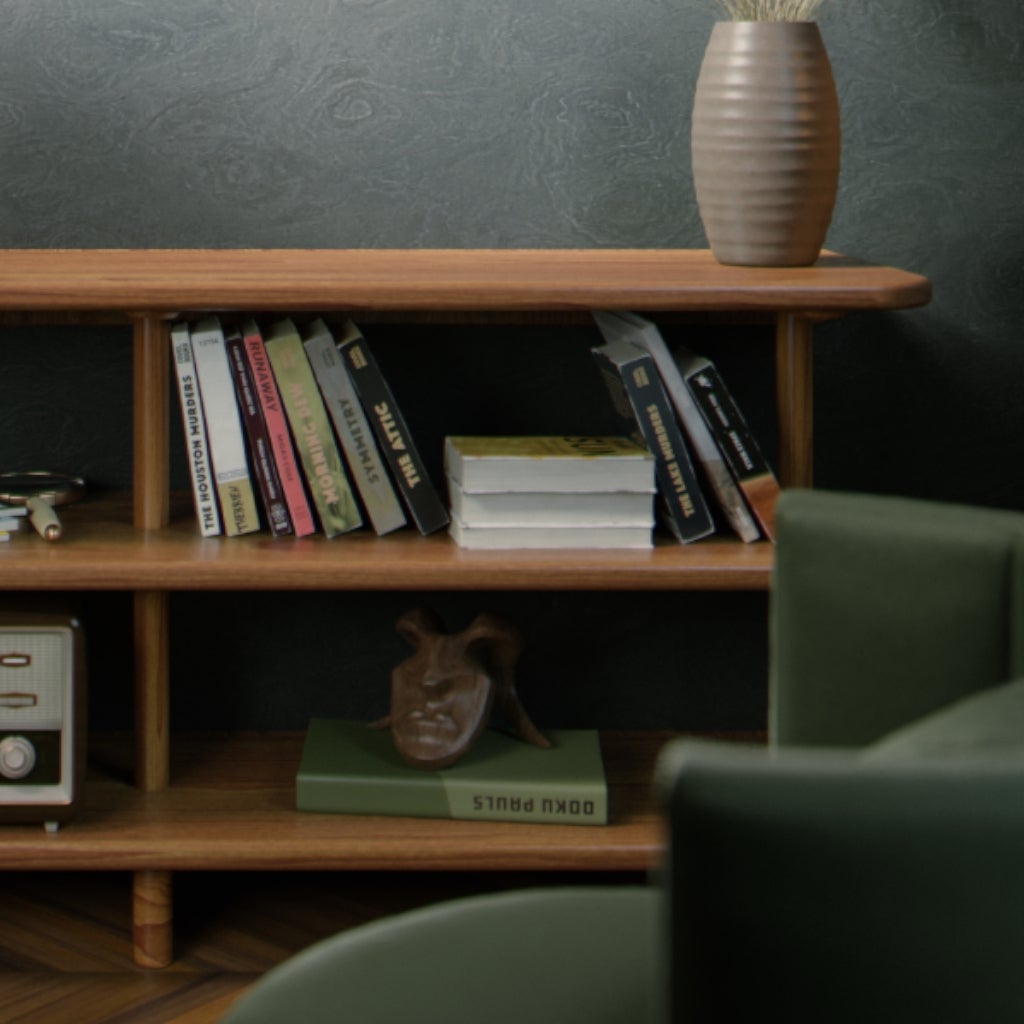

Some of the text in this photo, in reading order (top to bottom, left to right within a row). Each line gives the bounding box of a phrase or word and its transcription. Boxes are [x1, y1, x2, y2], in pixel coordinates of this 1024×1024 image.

[249, 341, 278, 412] RUNAWAY
[182, 375, 215, 530] THE HOUSTON MURDERS
[302, 422, 339, 504] MORNING
[338, 399, 380, 483] SYMMETRY
[374, 401, 421, 489] THE ATTIC
[645, 403, 675, 462] MURDERS
[678, 492, 696, 519] THE
[472, 795, 595, 815] DOKU PAULS
